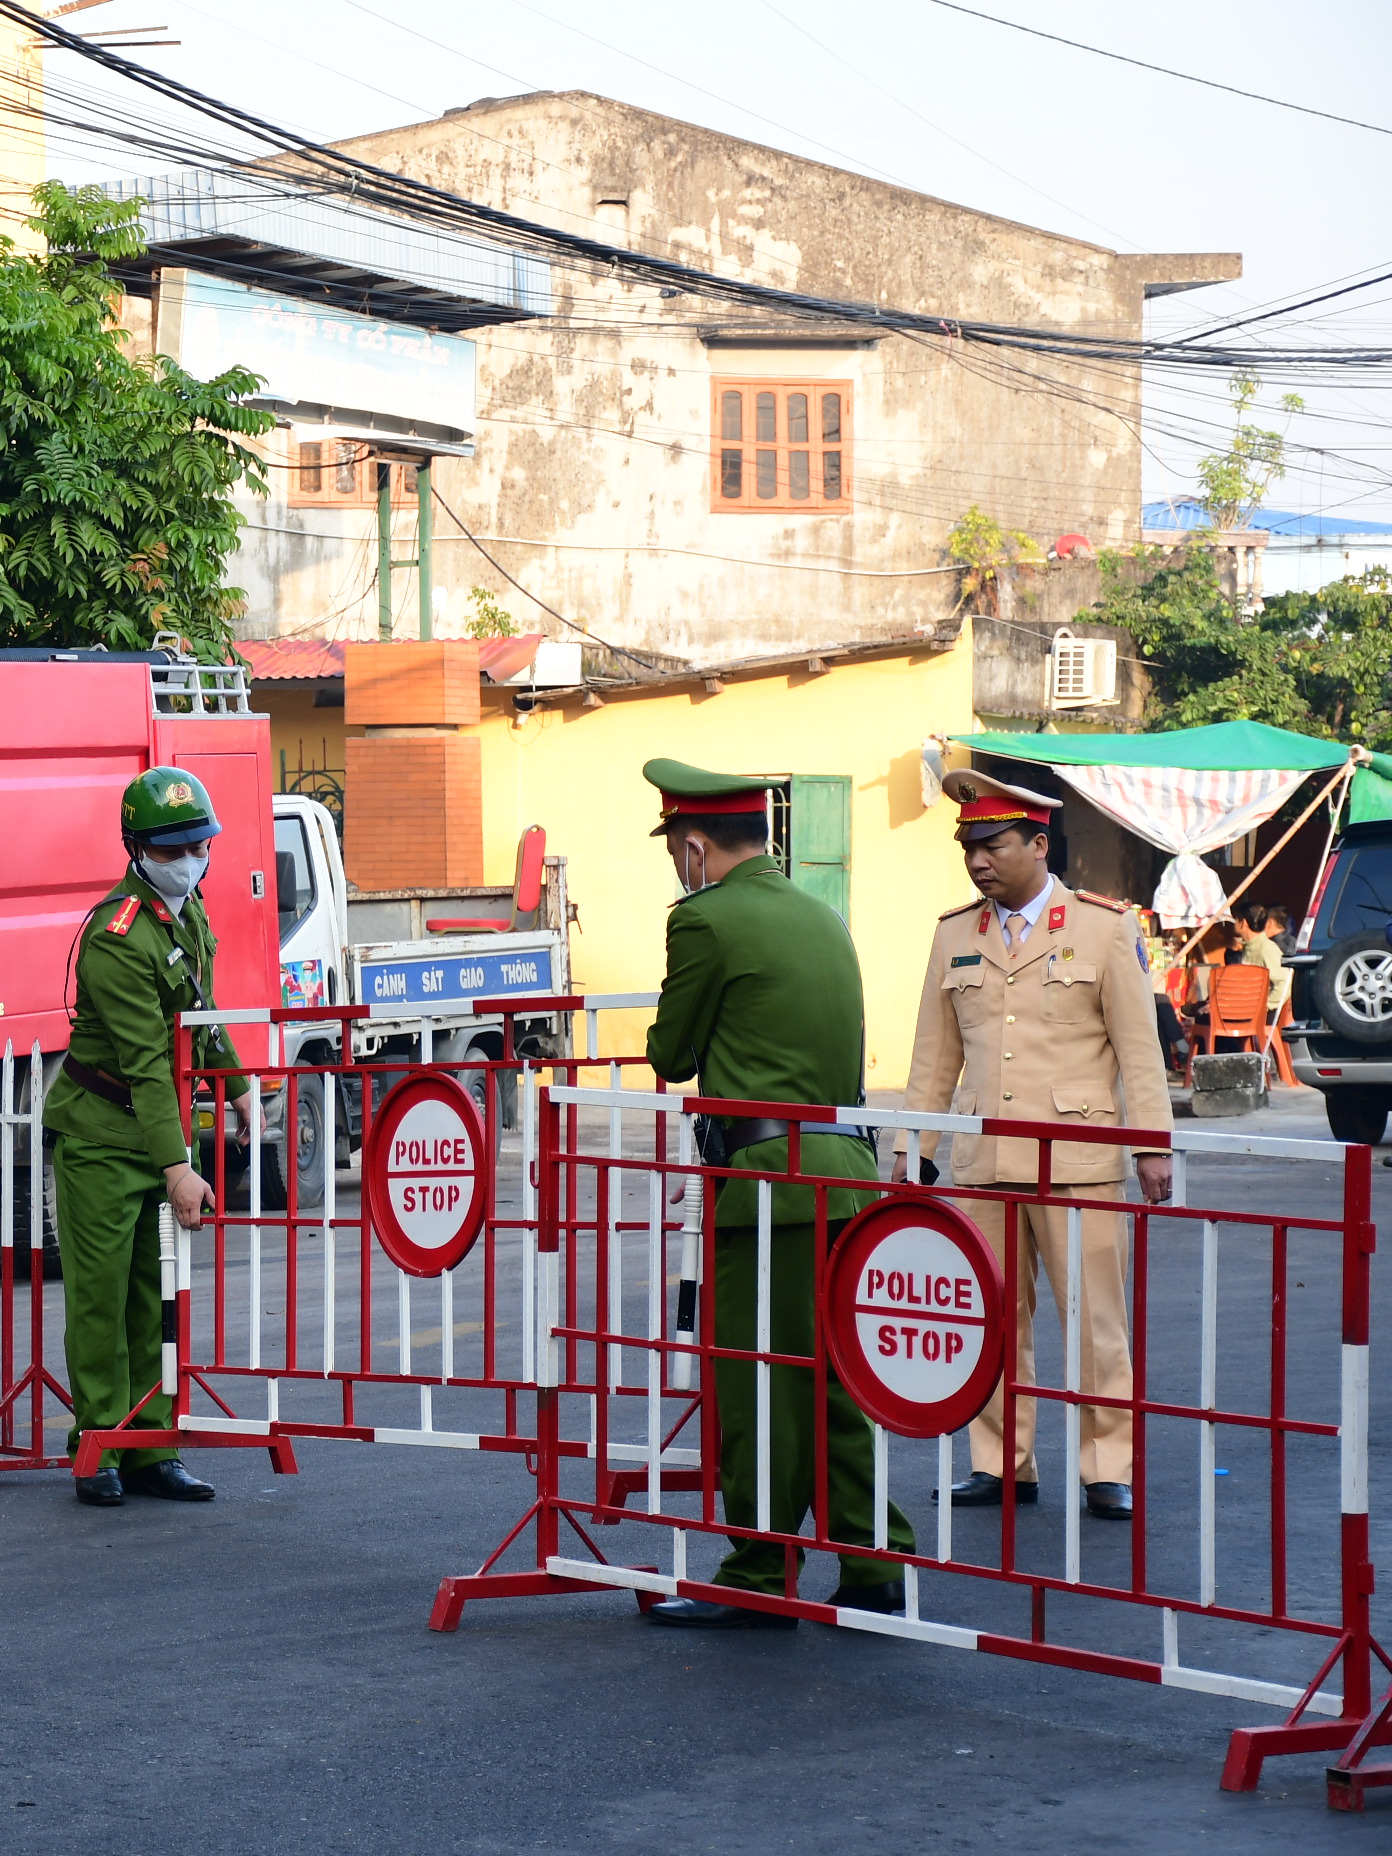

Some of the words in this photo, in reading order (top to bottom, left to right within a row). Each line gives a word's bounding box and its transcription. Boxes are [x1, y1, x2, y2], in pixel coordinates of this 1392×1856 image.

[322, 319, 353, 343] TY
[374, 969, 406, 997] CẢNH
[421, 966, 444, 993] SÁT
[459, 966, 484, 989] GIAO
[500, 959, 537, 985] THÔNG
[395, 1138, 466, 1166] POLICE
[403, 1185, 461, 1213] STOP
[867, 1268, 973, 1310] POLICE
[877, 1324, 964, 1364] STOP
